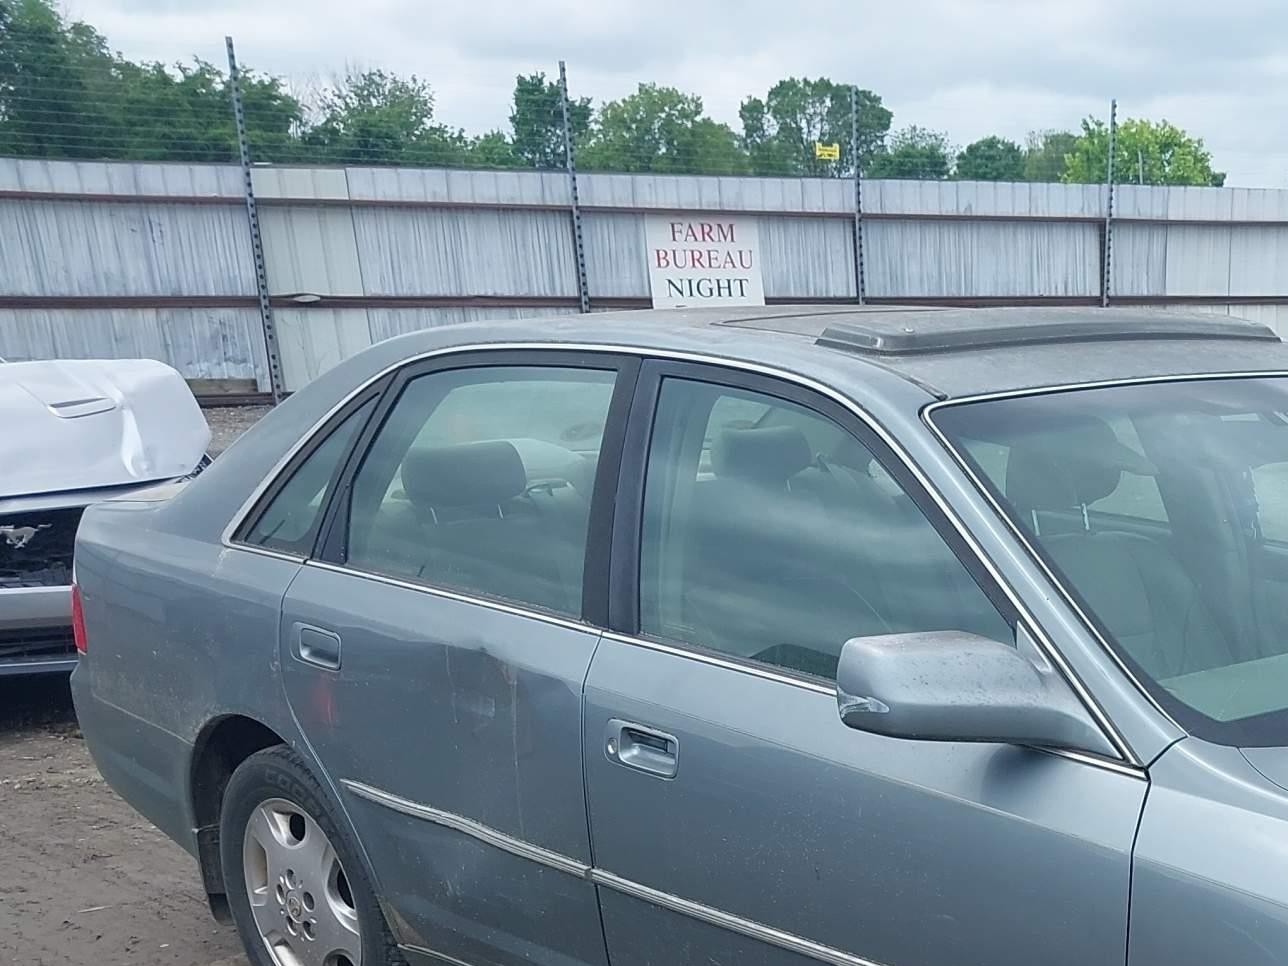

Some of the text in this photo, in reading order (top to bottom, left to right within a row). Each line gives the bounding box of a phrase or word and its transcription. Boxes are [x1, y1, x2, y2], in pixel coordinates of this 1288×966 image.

[669, 222, 736, 243] FARM
[655, 249, 753, 269] BUREAU
[665, 278, 749, 298] NIGHT
